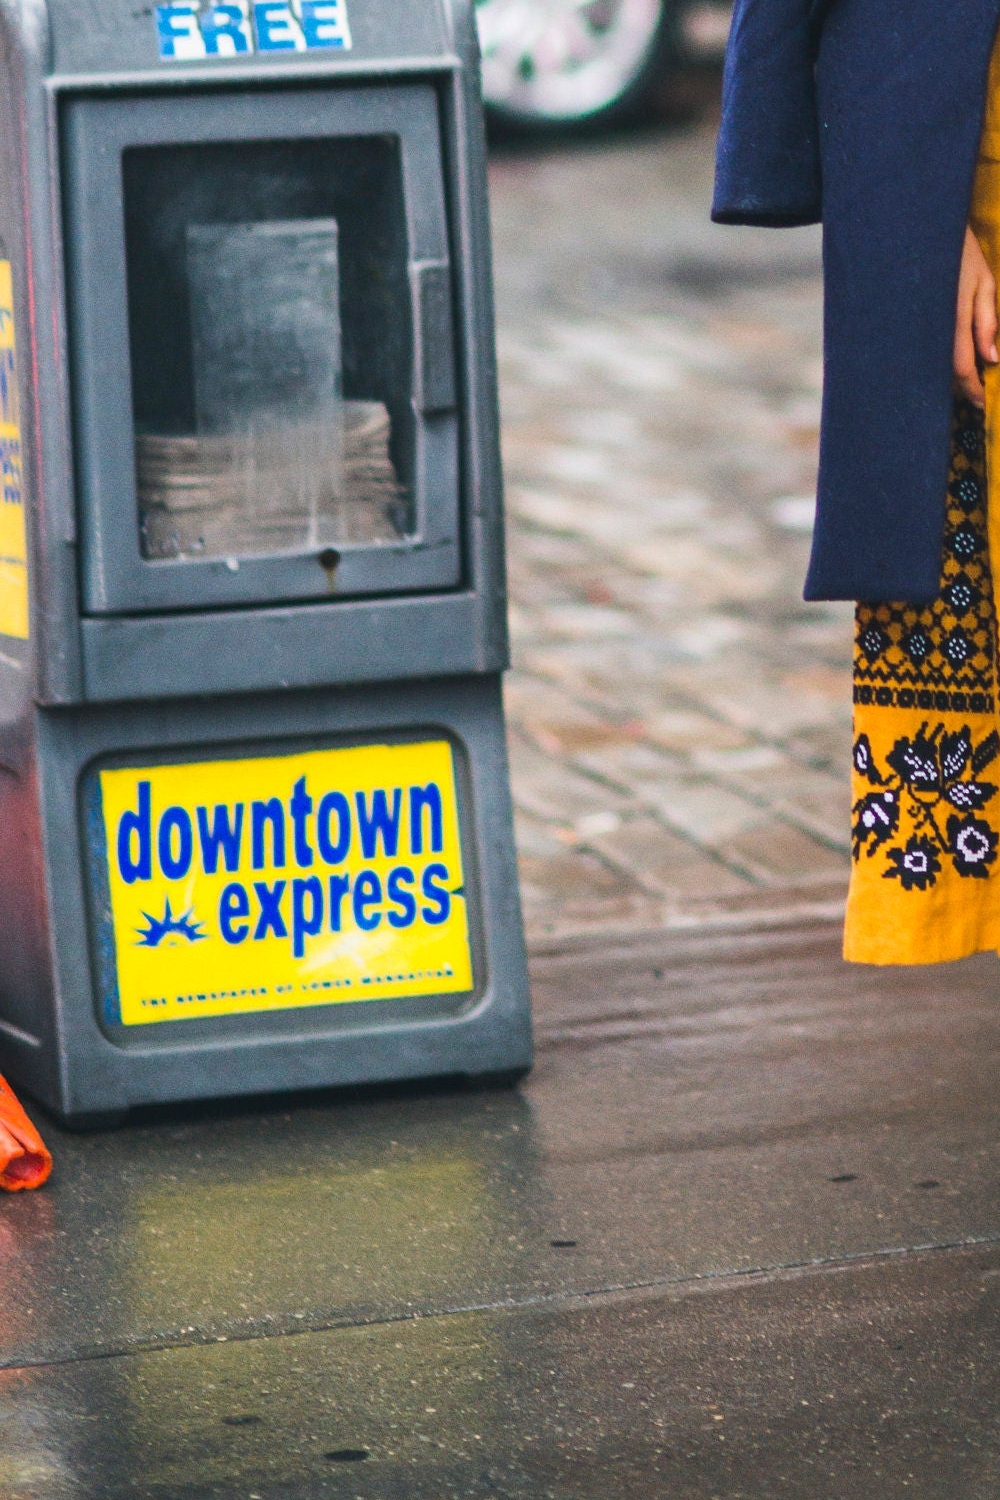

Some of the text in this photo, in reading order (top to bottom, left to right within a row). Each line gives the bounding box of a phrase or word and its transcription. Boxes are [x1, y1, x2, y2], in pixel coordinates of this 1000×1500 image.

[156, 0, 344, 56] FREE
[117, 775, 443, 884] downtown
[219, 863, 451, 958] express
